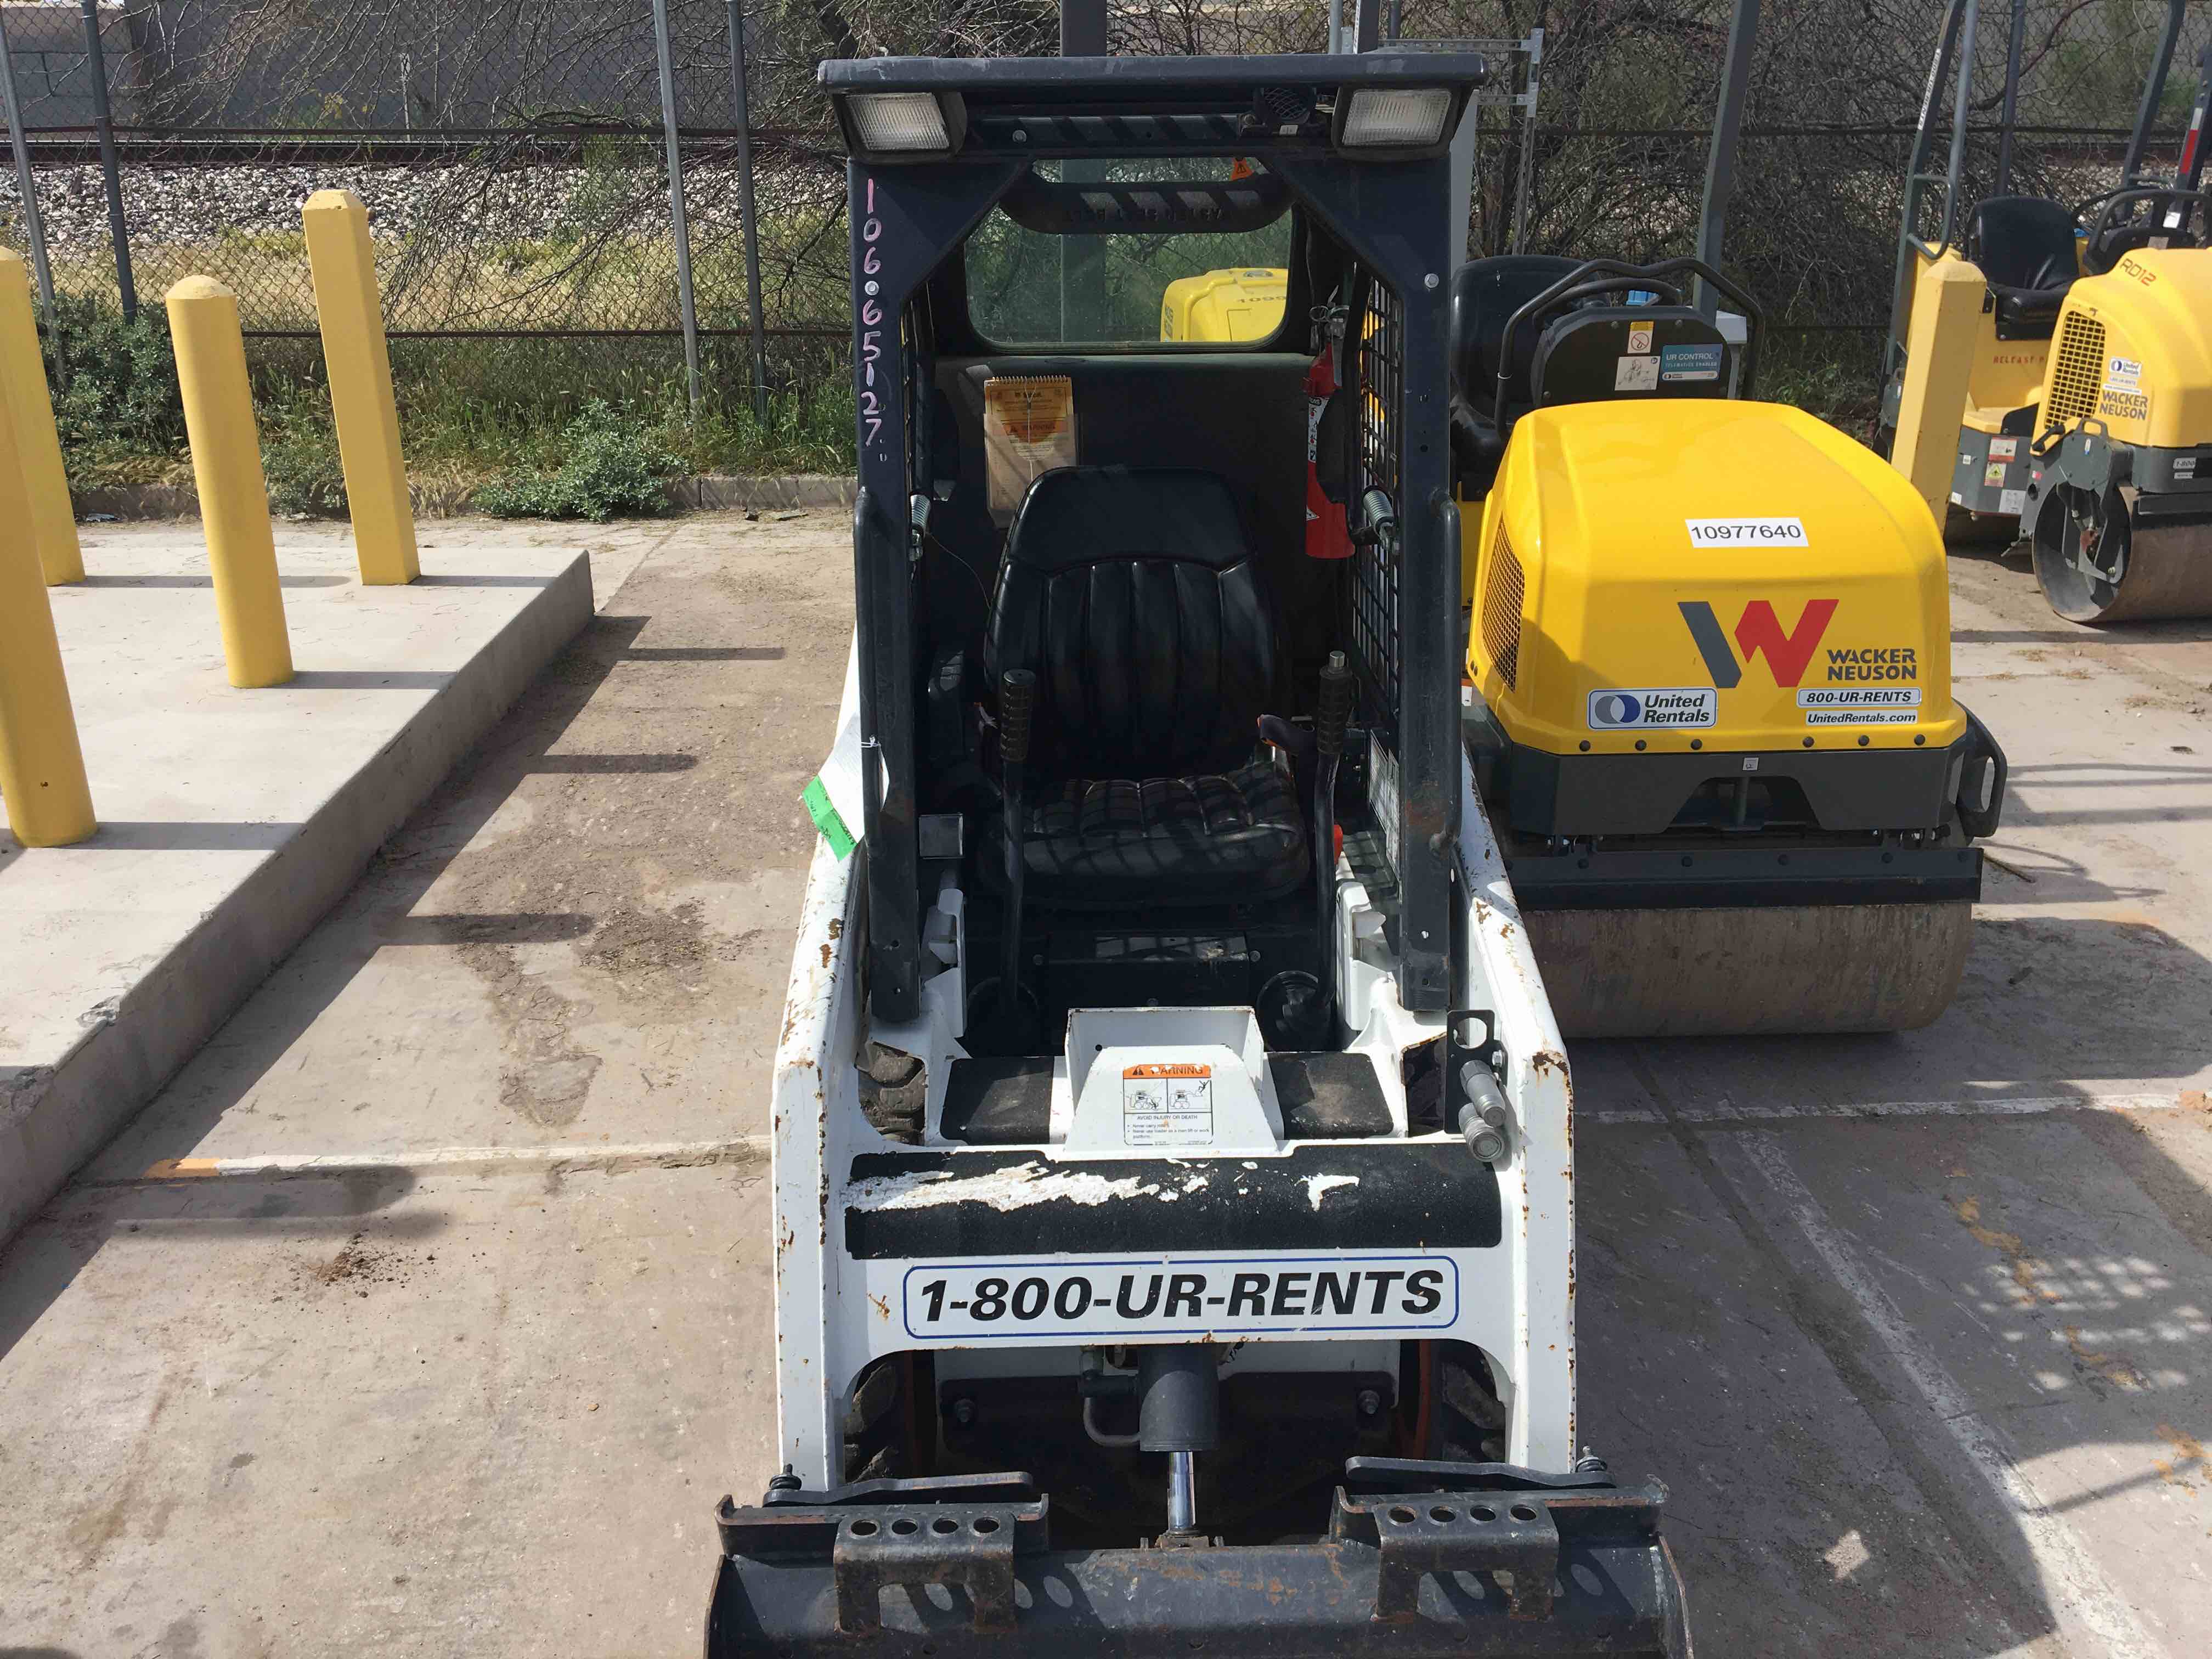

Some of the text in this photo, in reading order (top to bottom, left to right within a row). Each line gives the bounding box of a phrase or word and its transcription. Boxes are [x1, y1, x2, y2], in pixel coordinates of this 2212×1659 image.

[2119, 258, 2157, 286] RD12
[1679, 352, 1713, 360] CONTROL
[2102, 390, 2148, 408] WACKER
[2100, 402, 2147, 420] NEUSON
[1691, 525, 1801, 539] 10977640
[1827, 648, 1917, 664] WACKER
[1827, 665, 1916, 681] NEUSON
[1645, 693, 1706, 708] United
[1807, 691, 1911, 703] 800-UR-RENTS
[1644, 709, 1709, 723] Rentals
[1808, 713, 1916, 723] UnitedRentals.com
[920, 1269, 1444, 1322] 1-800-UR-RENTS
